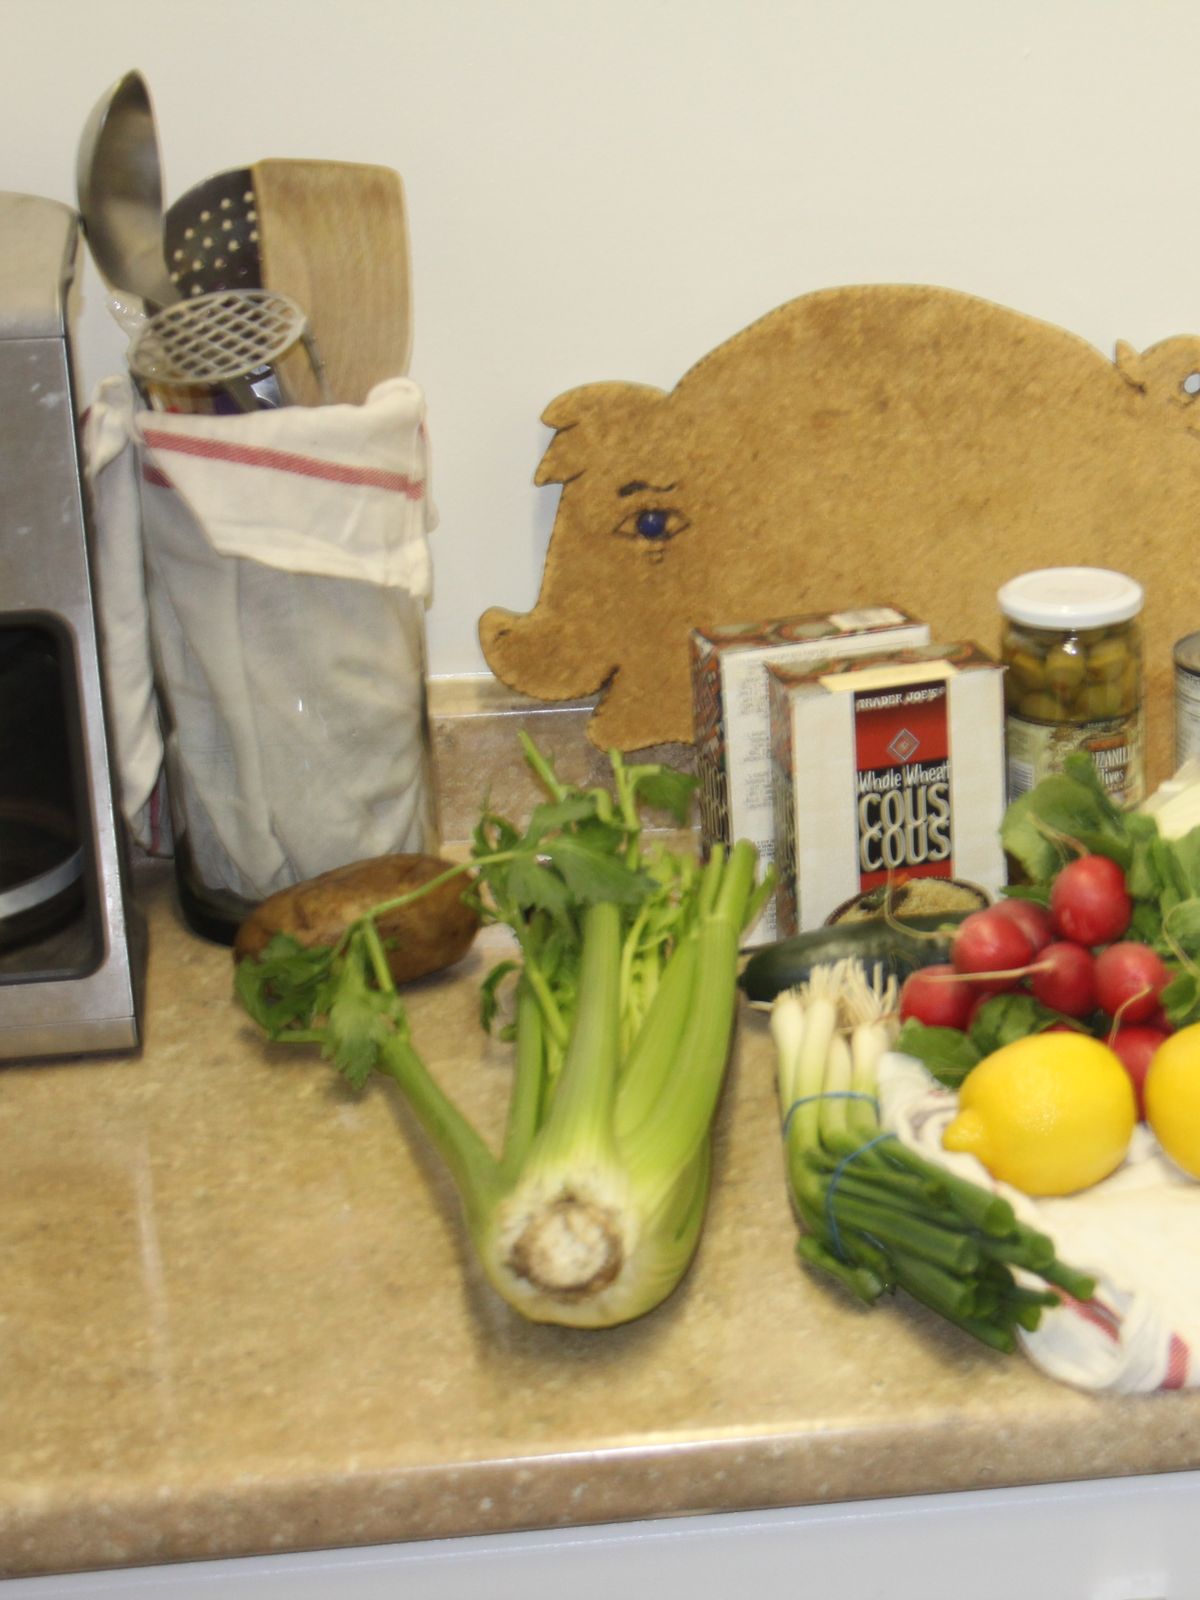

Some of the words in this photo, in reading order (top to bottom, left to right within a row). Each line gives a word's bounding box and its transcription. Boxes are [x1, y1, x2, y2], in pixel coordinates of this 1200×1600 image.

[856, 693, 903, 712] TRADER
[857, 768, 902, 793] Whole
[902, 762, 951, 787] Wheat
[859, 782, 950, 833] COUS
[860, 819, 952, 872] COUS
